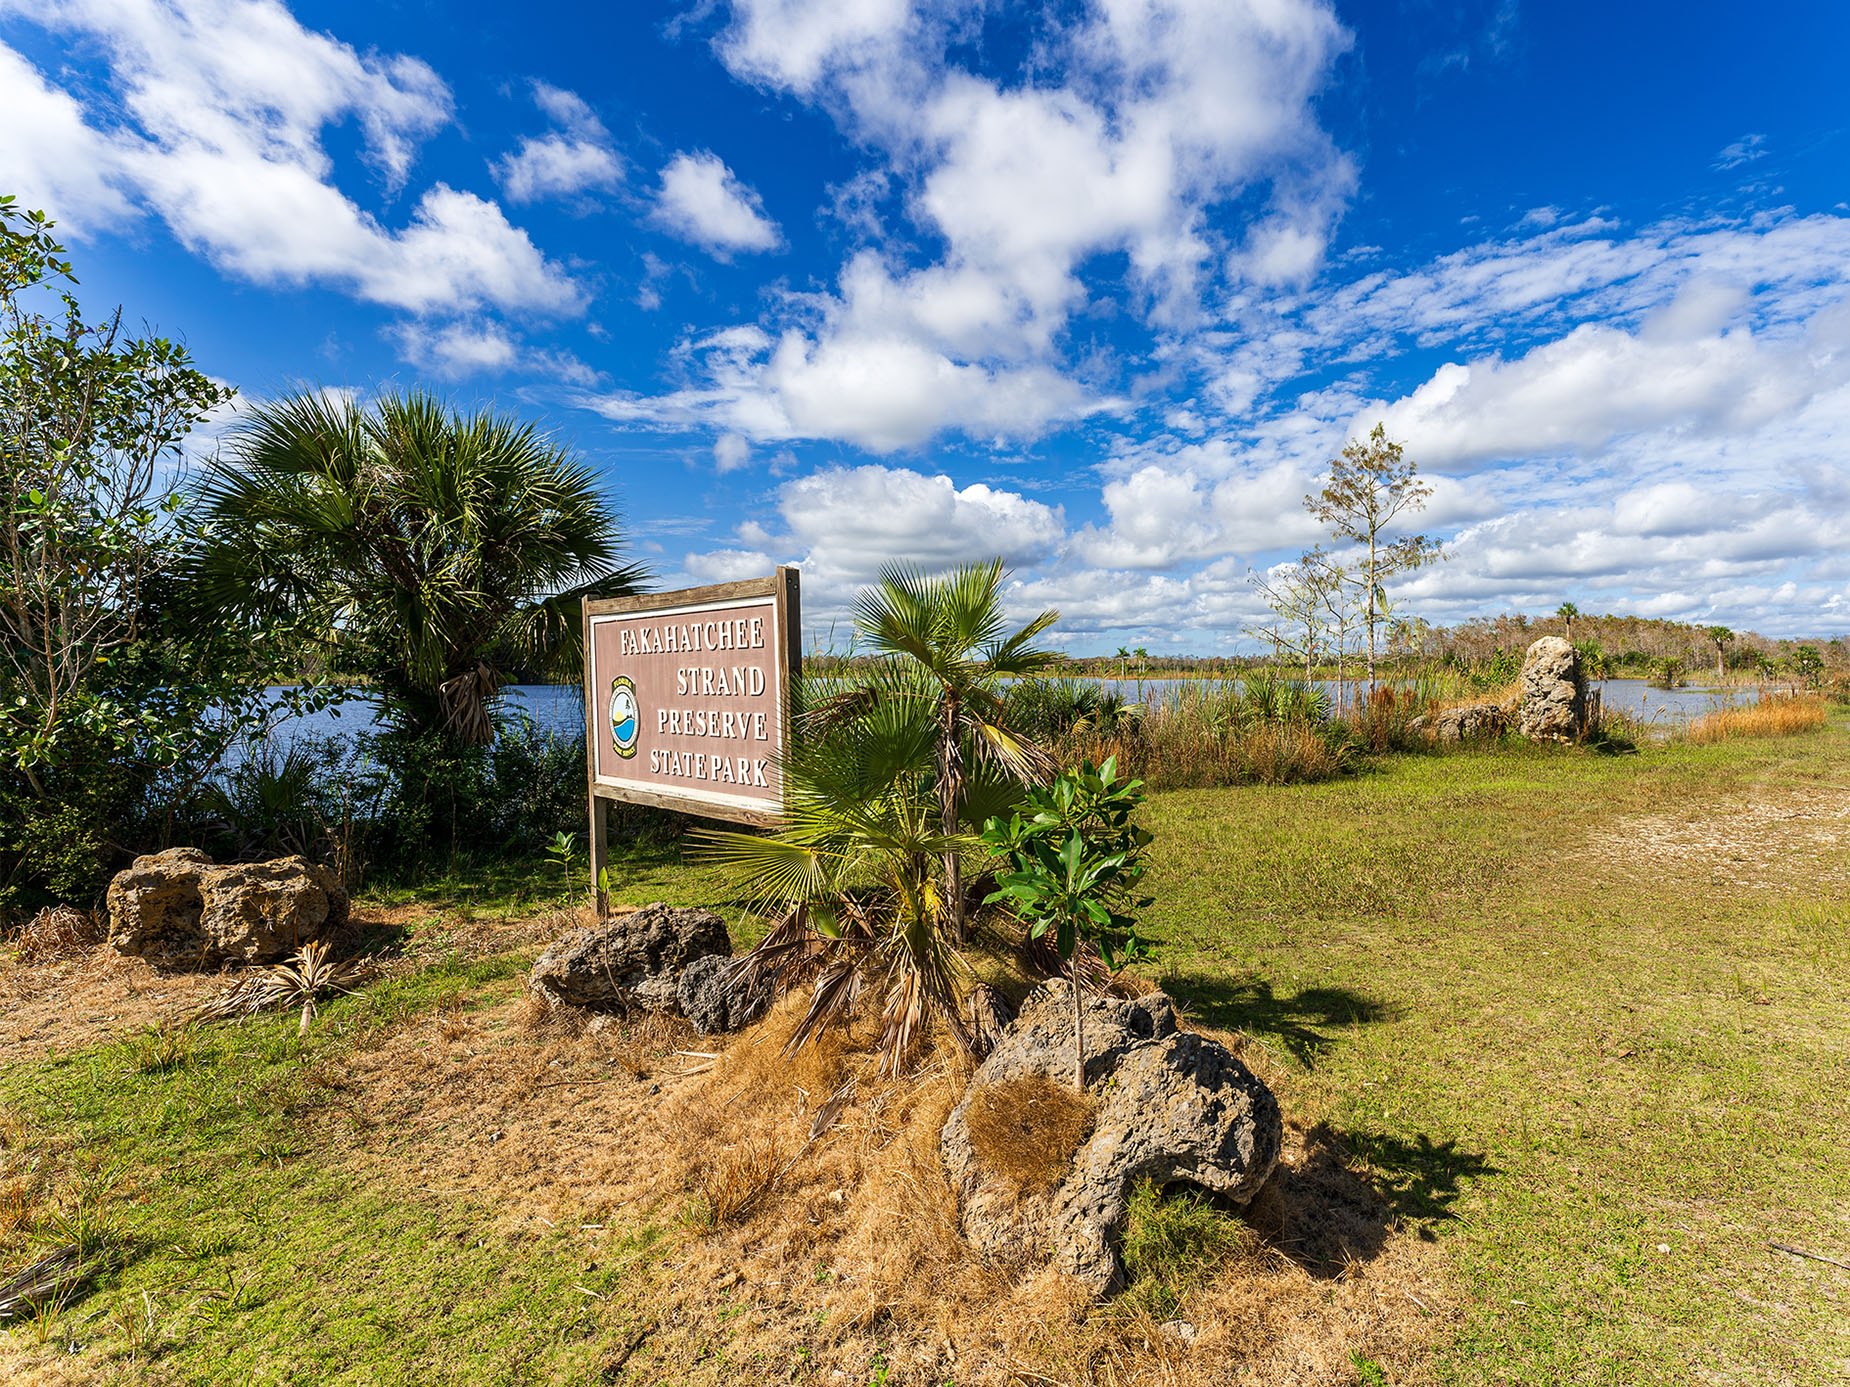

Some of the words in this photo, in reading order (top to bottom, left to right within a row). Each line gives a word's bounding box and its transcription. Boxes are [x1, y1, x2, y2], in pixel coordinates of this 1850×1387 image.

[621, 617, 765, 655] FAKAHATCHEE
[677, 666, 766, 697] STRAND
[657, 709, 768, 741] PRESERVE
[650, 749, 708, 780] STATE
[710, 755, 769, 788] PARK
